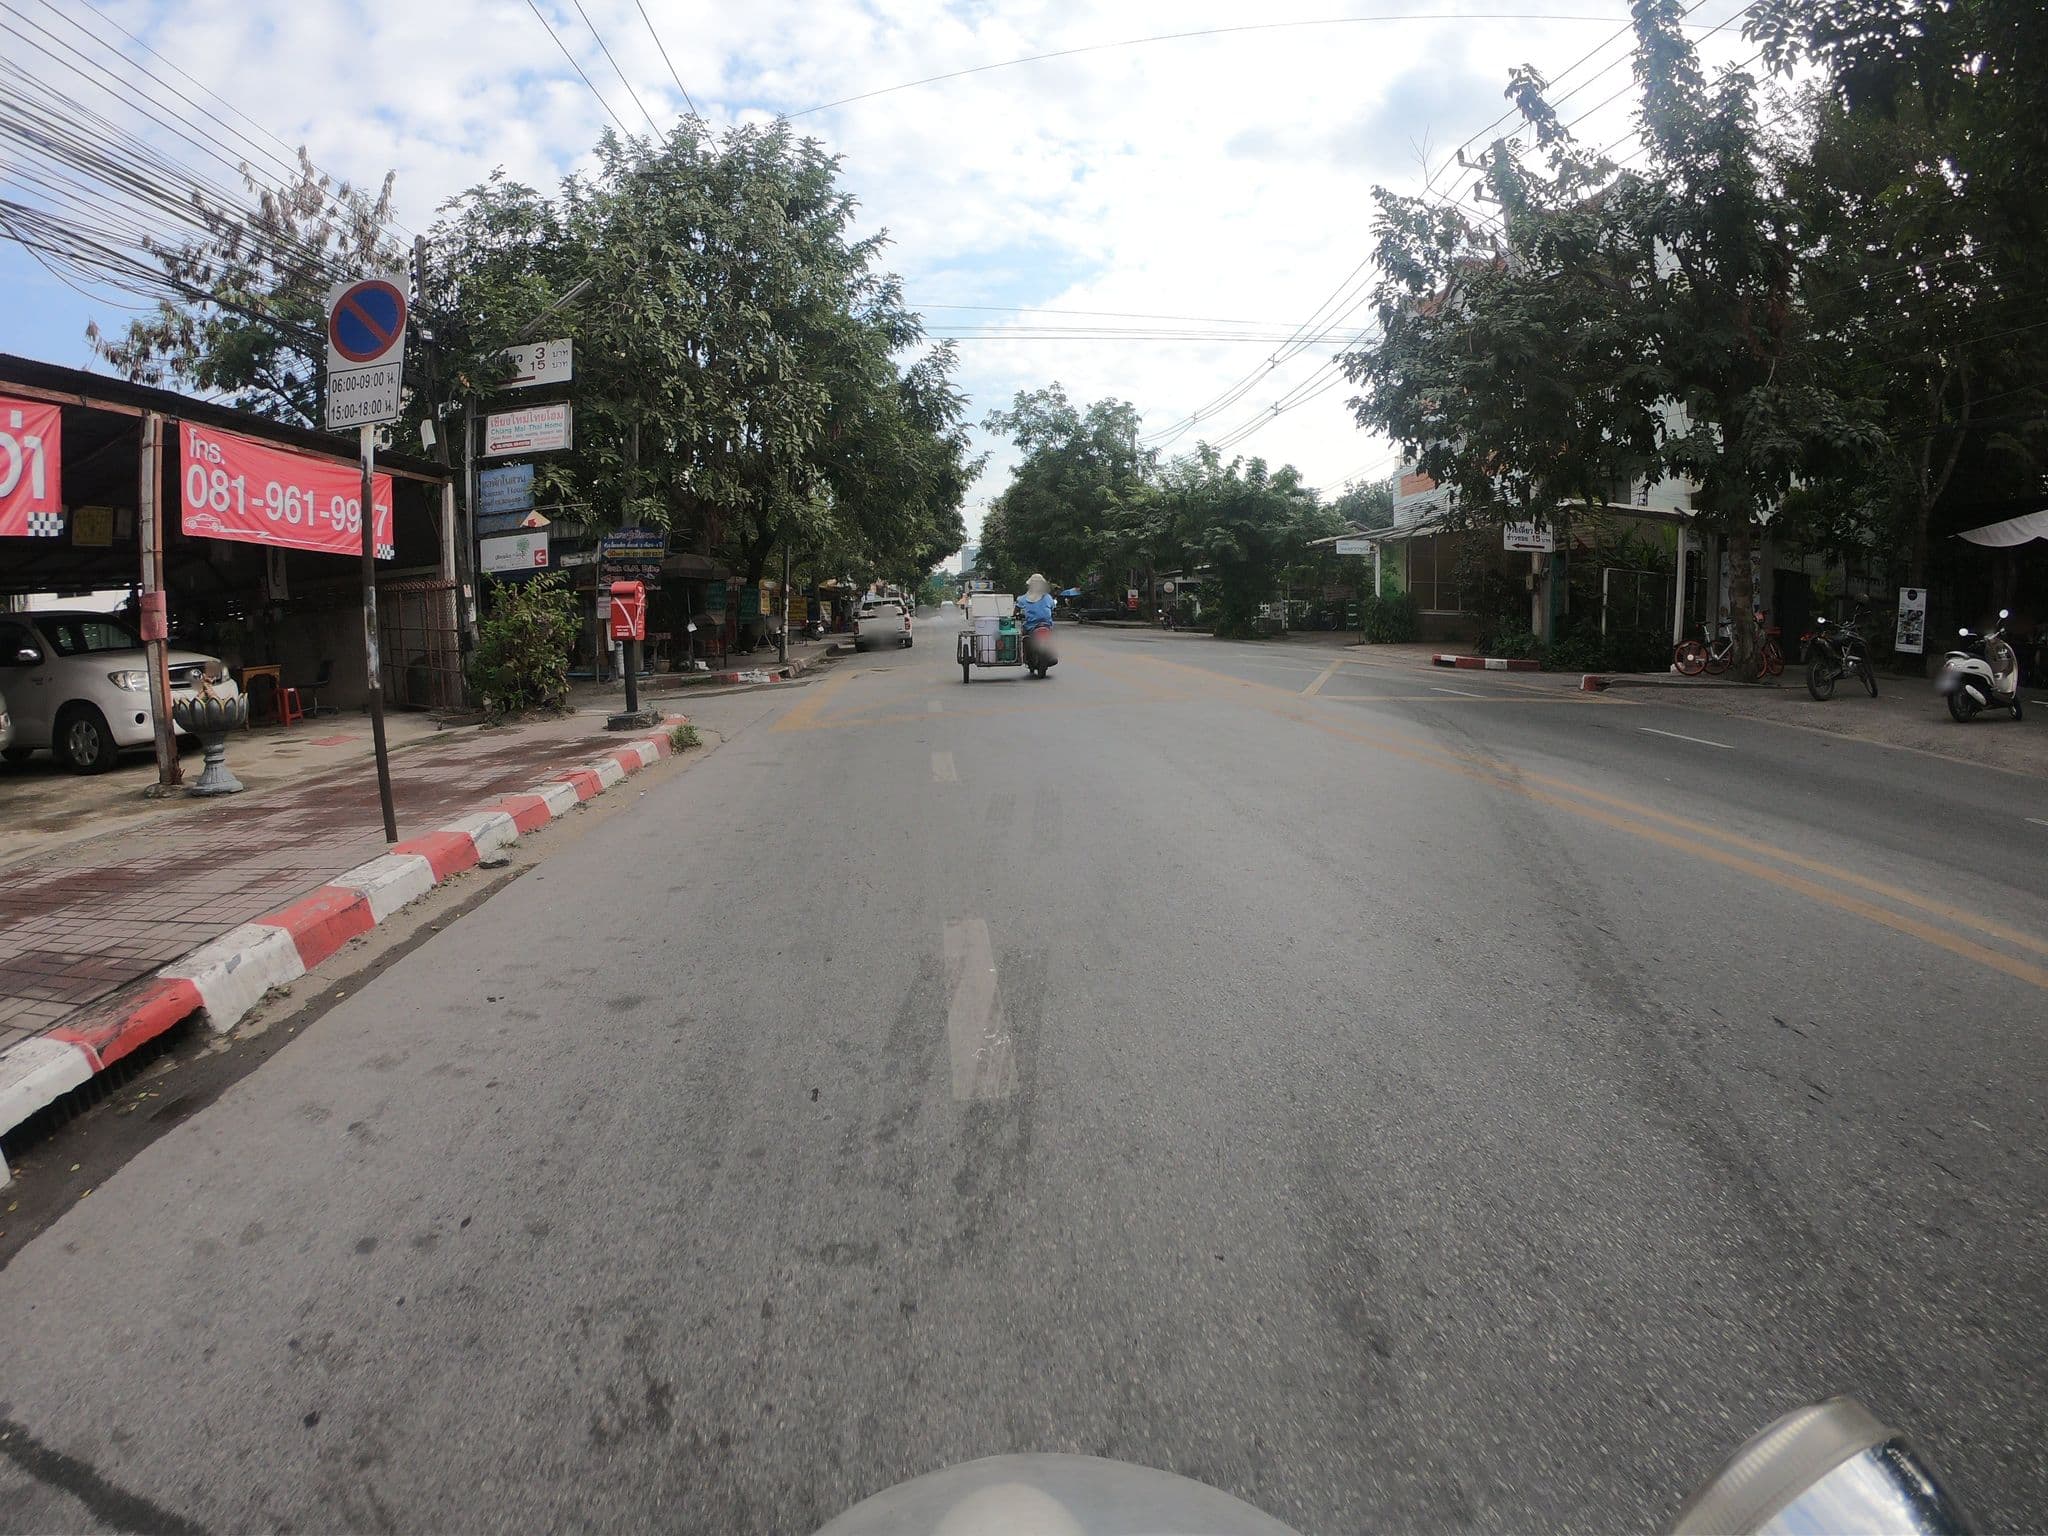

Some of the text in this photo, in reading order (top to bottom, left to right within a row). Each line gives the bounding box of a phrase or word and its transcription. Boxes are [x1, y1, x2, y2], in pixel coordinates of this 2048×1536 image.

[535, 347, 545, 359] 3
[552, 349, 569, 358] บาท
[530, 360, 546, 371] 15
[332, 372, 384, 393] 06:00-09:00
[331, 399, 382, 420] 15:00-18:00
[189, 427, 226, 465] โทร.
[186, 464, 389, 538] 081-961-997
